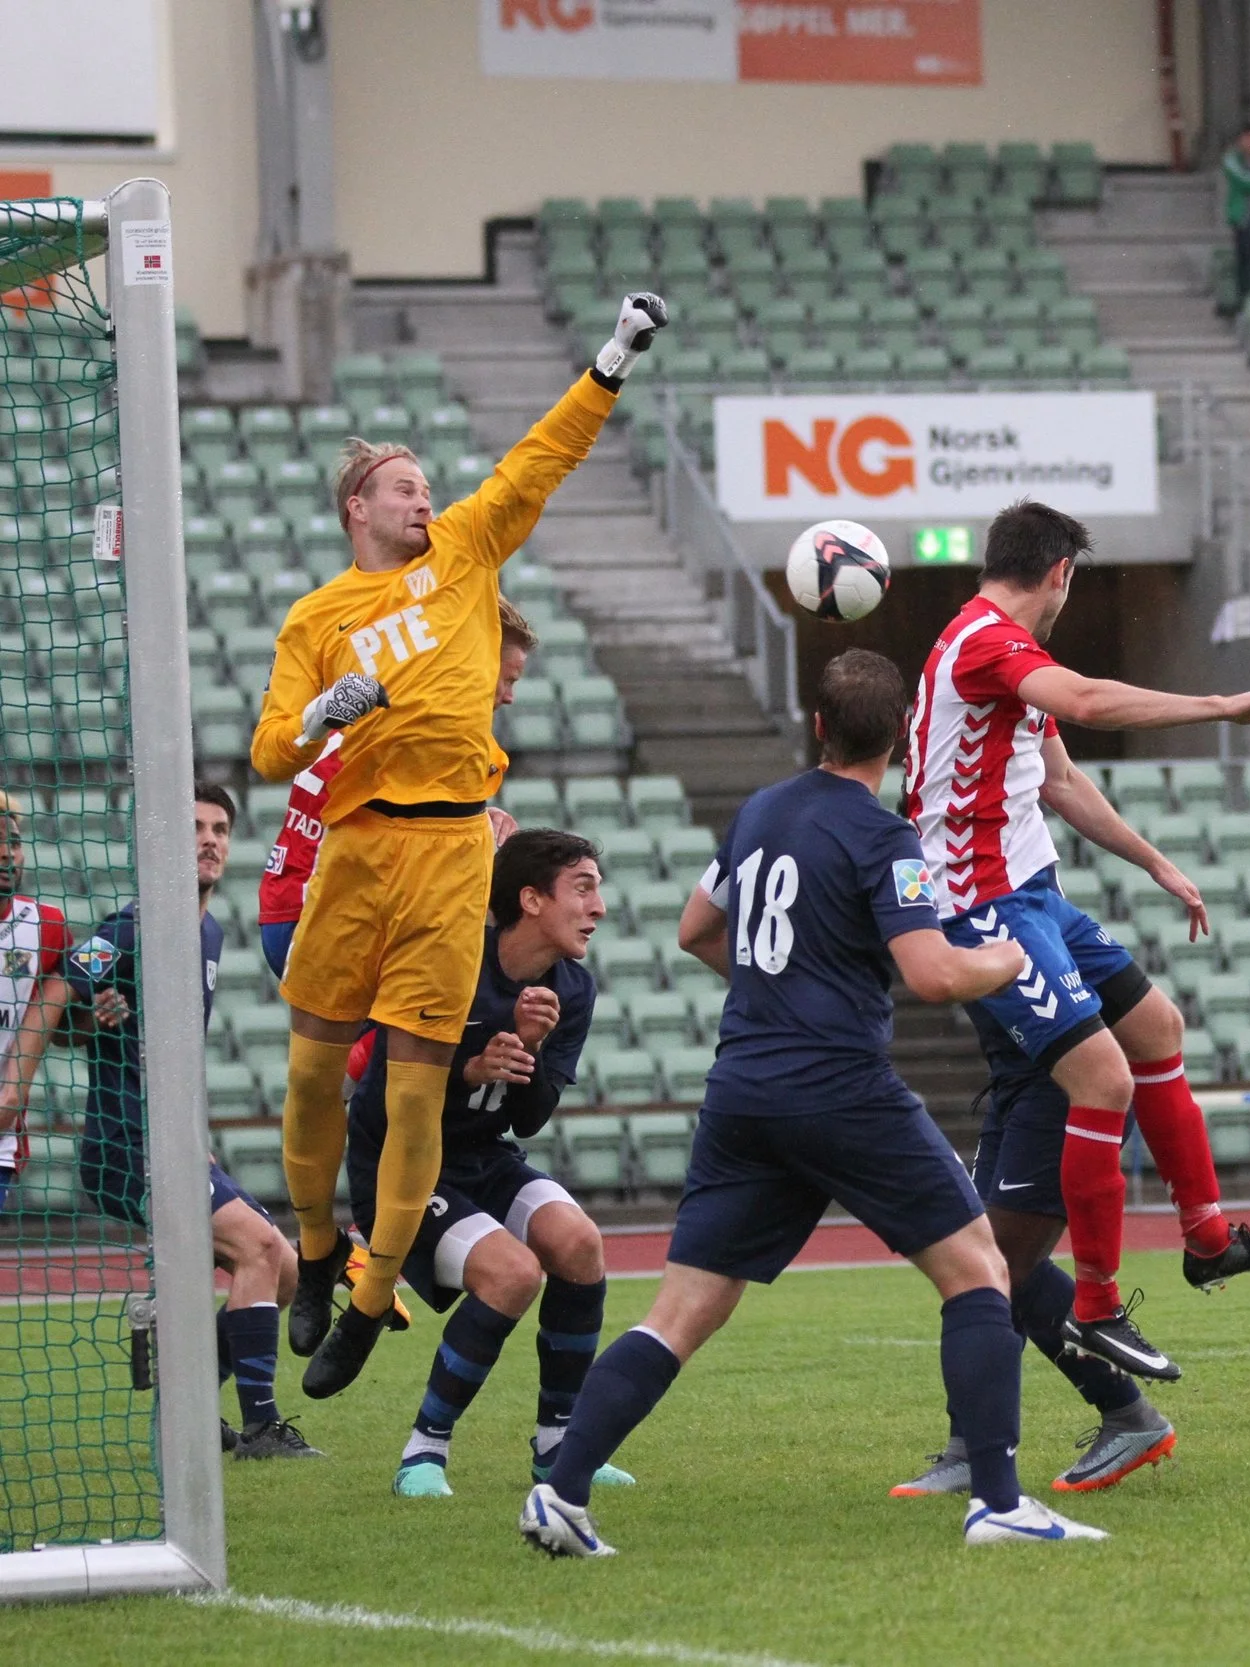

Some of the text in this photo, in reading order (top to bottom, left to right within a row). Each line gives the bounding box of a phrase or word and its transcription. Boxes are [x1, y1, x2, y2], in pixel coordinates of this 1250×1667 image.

[762, 414, 917, 498] NG
[928, 424, 1019, 451] Norsk
[928, 458, 1114, 490] Gjenvinning
[349, 603, 439, 678] PTE
[736, 847, 799, 975] 18
